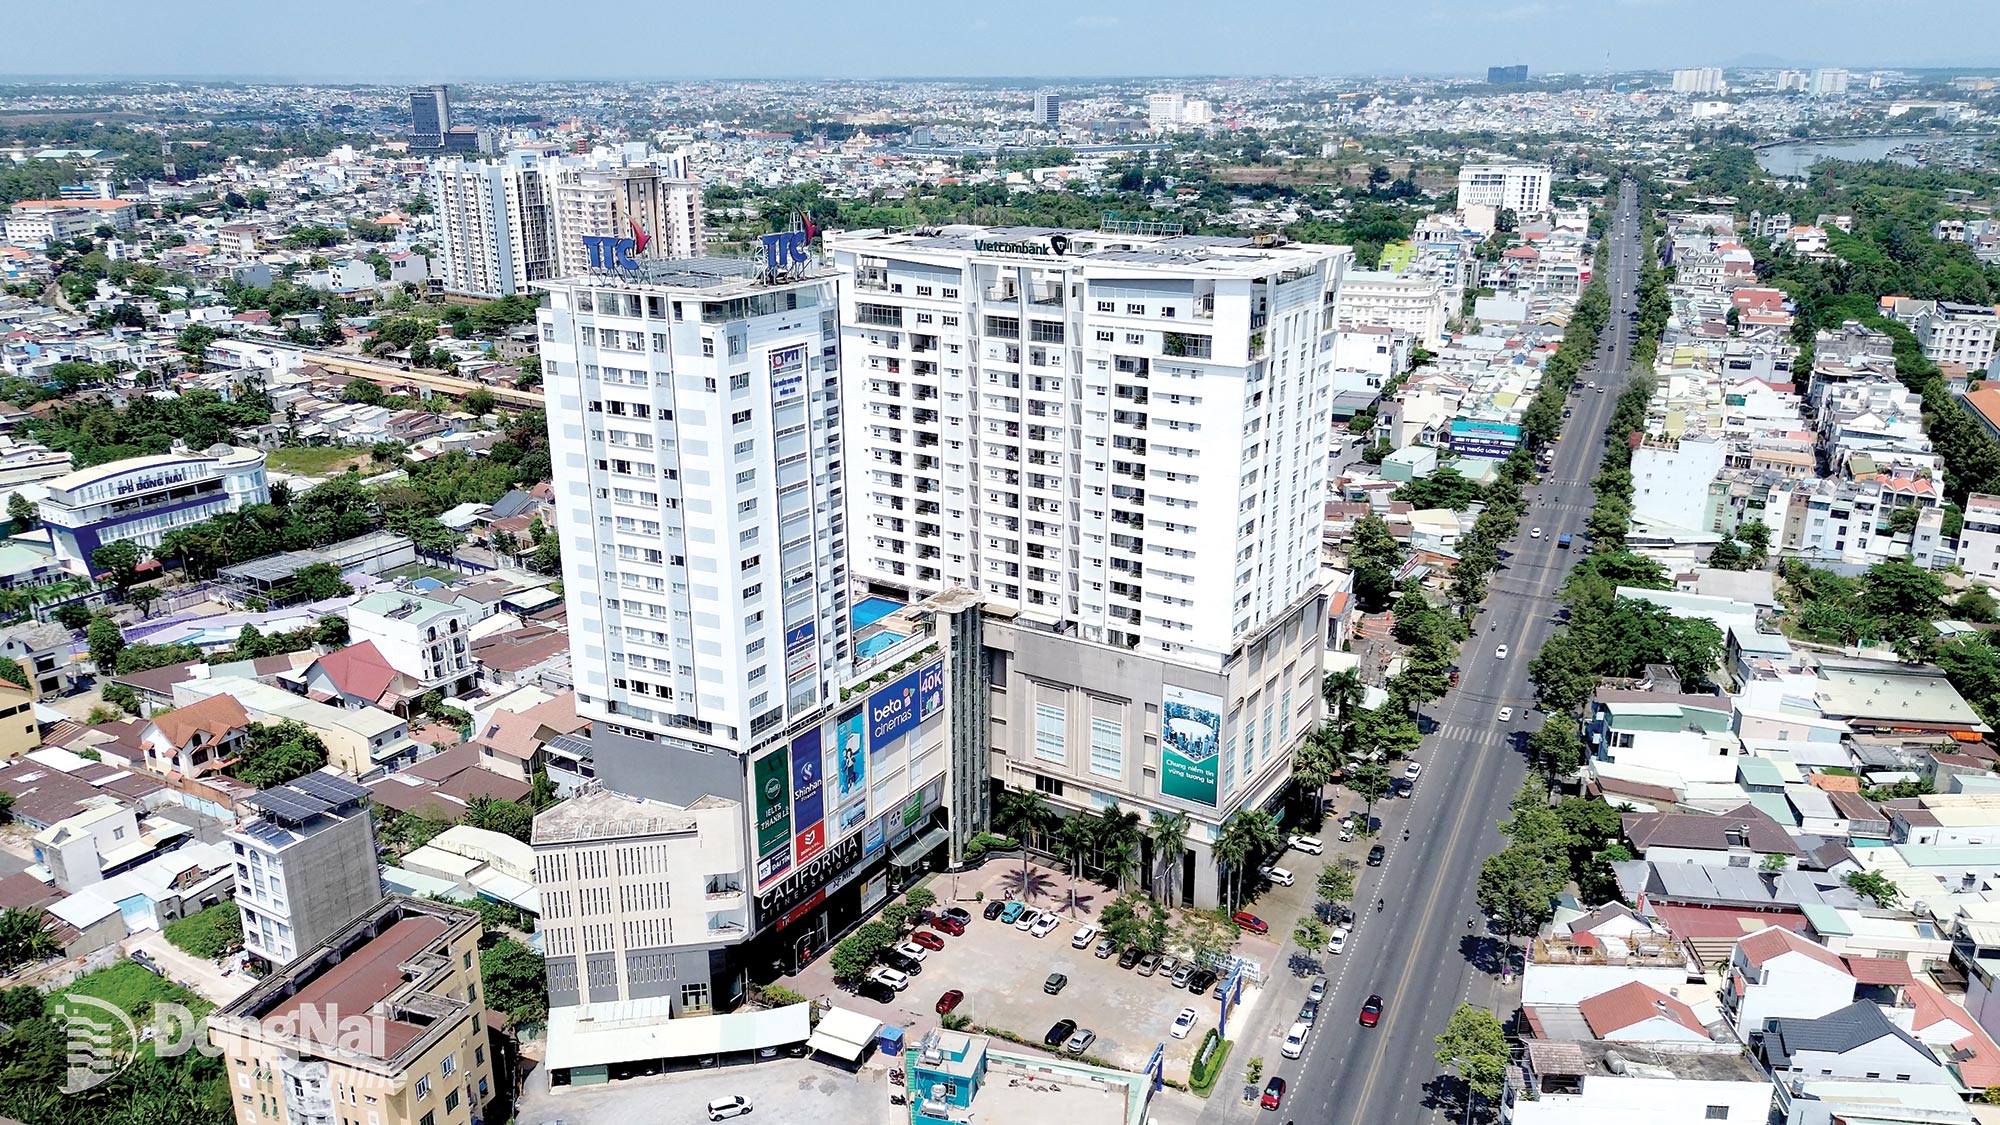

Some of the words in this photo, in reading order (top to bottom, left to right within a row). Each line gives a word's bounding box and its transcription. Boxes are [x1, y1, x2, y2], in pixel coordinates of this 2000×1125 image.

[582, 235, 640, 270] TTC
[762, 231, 808, 268] TTC
[974, 239, 1050, 256] Vietcombank
[165, 474, 183, 485] NAI
[922, 670, 942, 694] 40K
[874, 699, 902, 722] beta
[874, 708, 912, 738] cinemas
[1166, 759, 1186, 770] Chung
[794, 779, 822, 801] Shinhan
[760, 812, 782, 830] THANH
[765, 802, 782, 818] IELTS
[761, 836, 858, 910] CALIFORNIA
[760, 879, 816, 923] FITNESS
[828, 850, 858, 876] YOGA
